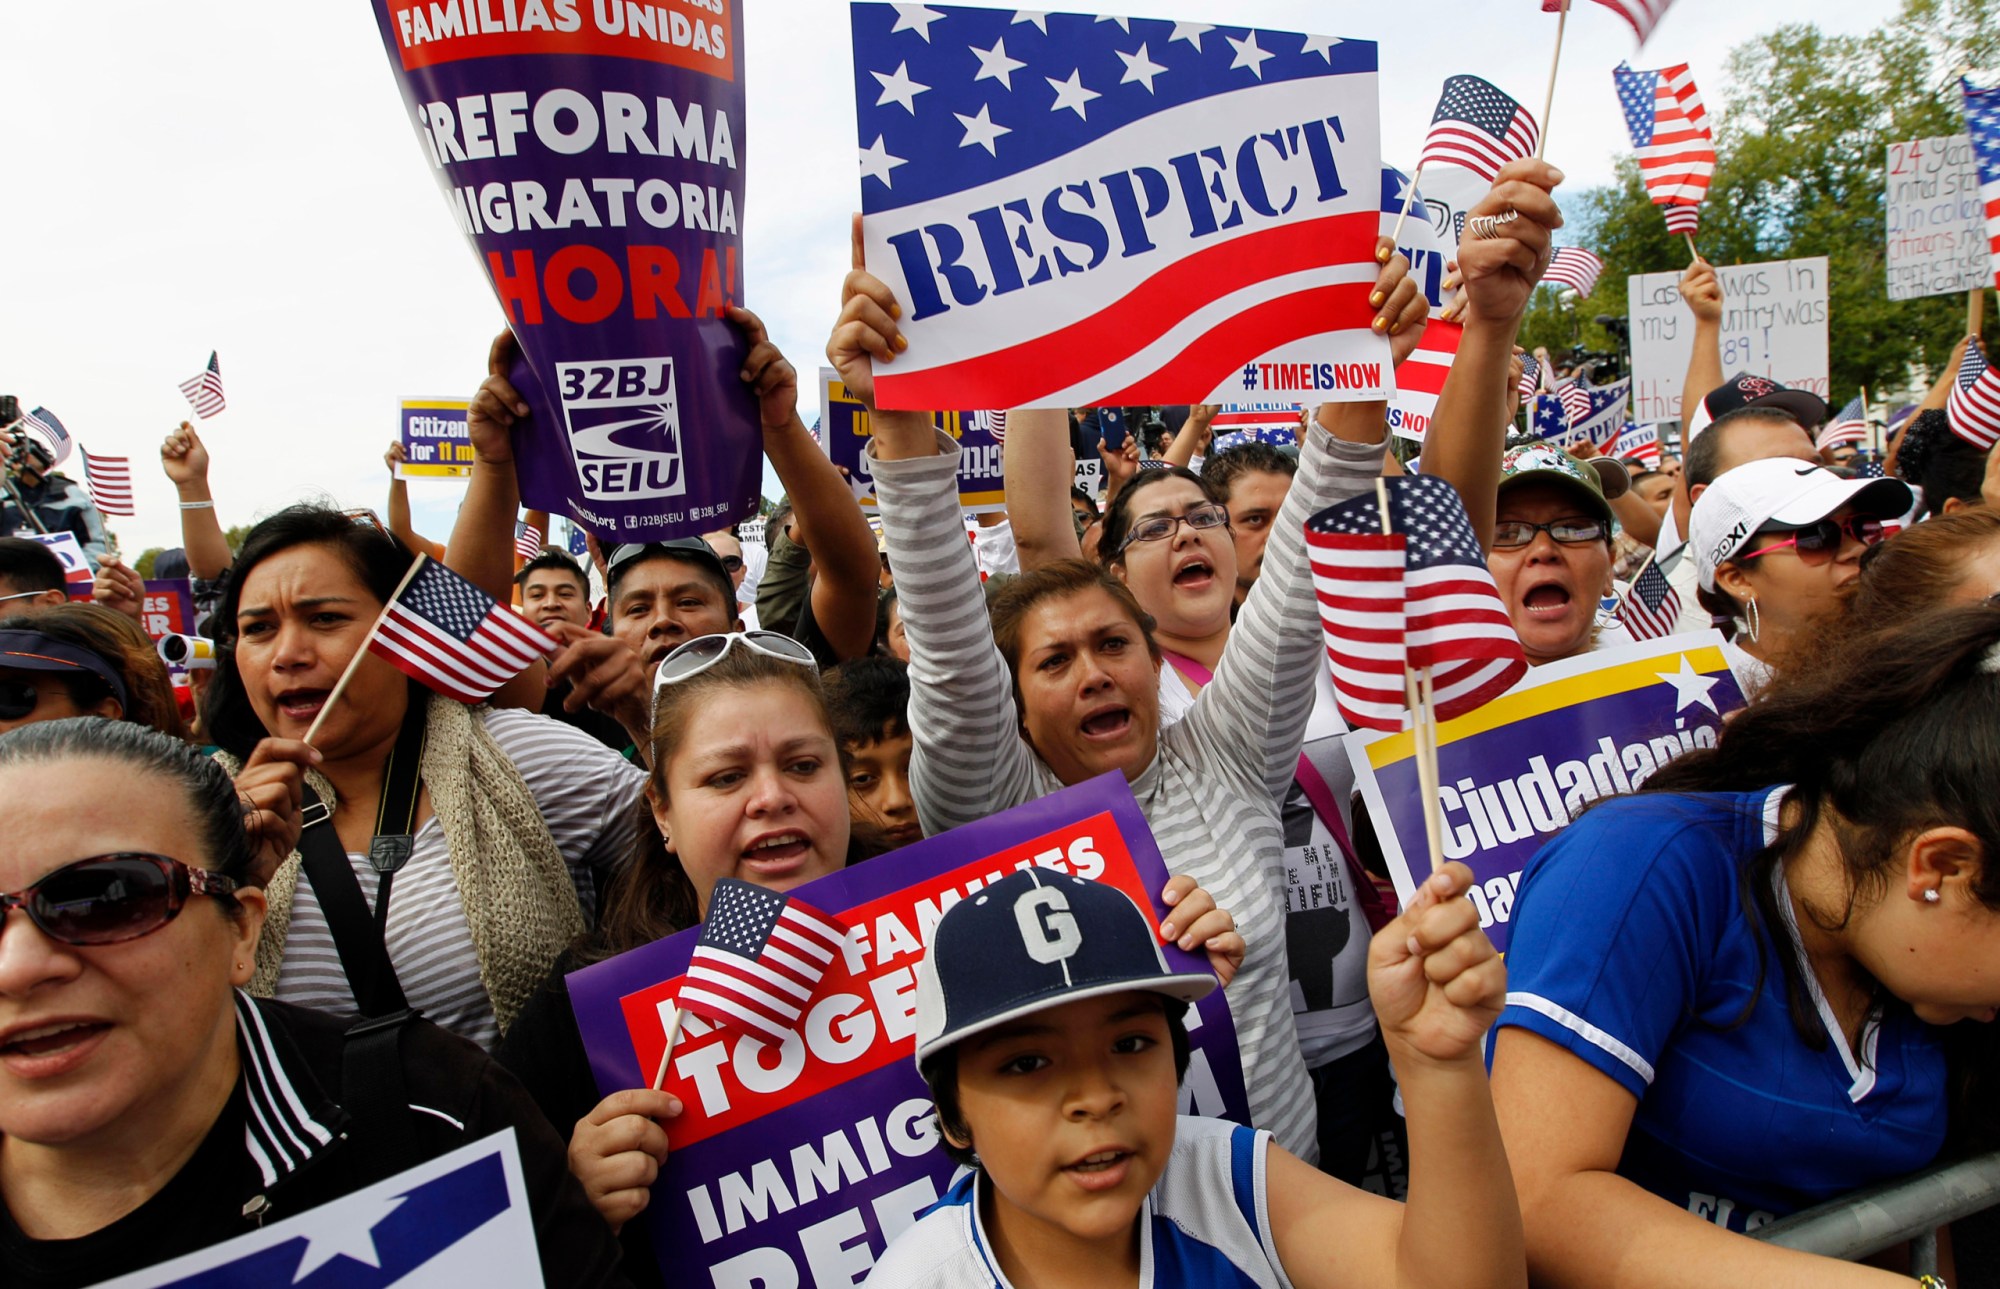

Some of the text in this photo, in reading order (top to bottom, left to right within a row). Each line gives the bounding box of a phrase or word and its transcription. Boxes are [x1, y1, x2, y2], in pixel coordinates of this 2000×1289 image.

[397, 0, 726, 60] FAMILIAS UNIDAS
[445, 178, 738, 236] MIGRATORIA
[886, 115, 1348, 322] RESPECT
[1720, 270, 1770, 298] was
[1640, 293, 1826, 341] my untry was
[562, 364, 672, 401] 32BJ
[1242, 363, 1381, 391] #TIMEISNOW
[1237, 401, 1293, 411] MILLION
[1636, 379, 1683, 420] this
[409, 442, 435, 461] for
[438, 441, 452, 461] 11
[960, 444, 1003, 480] Citi
[582, 459, 680, 494] SEIU
[1710, 521, 1747, 568] 20XI
[1013, 885, 1083, 965] G
[674, 960, 924, 1119] TOGE
[687, 1097, 940, 1245] IMMIG
